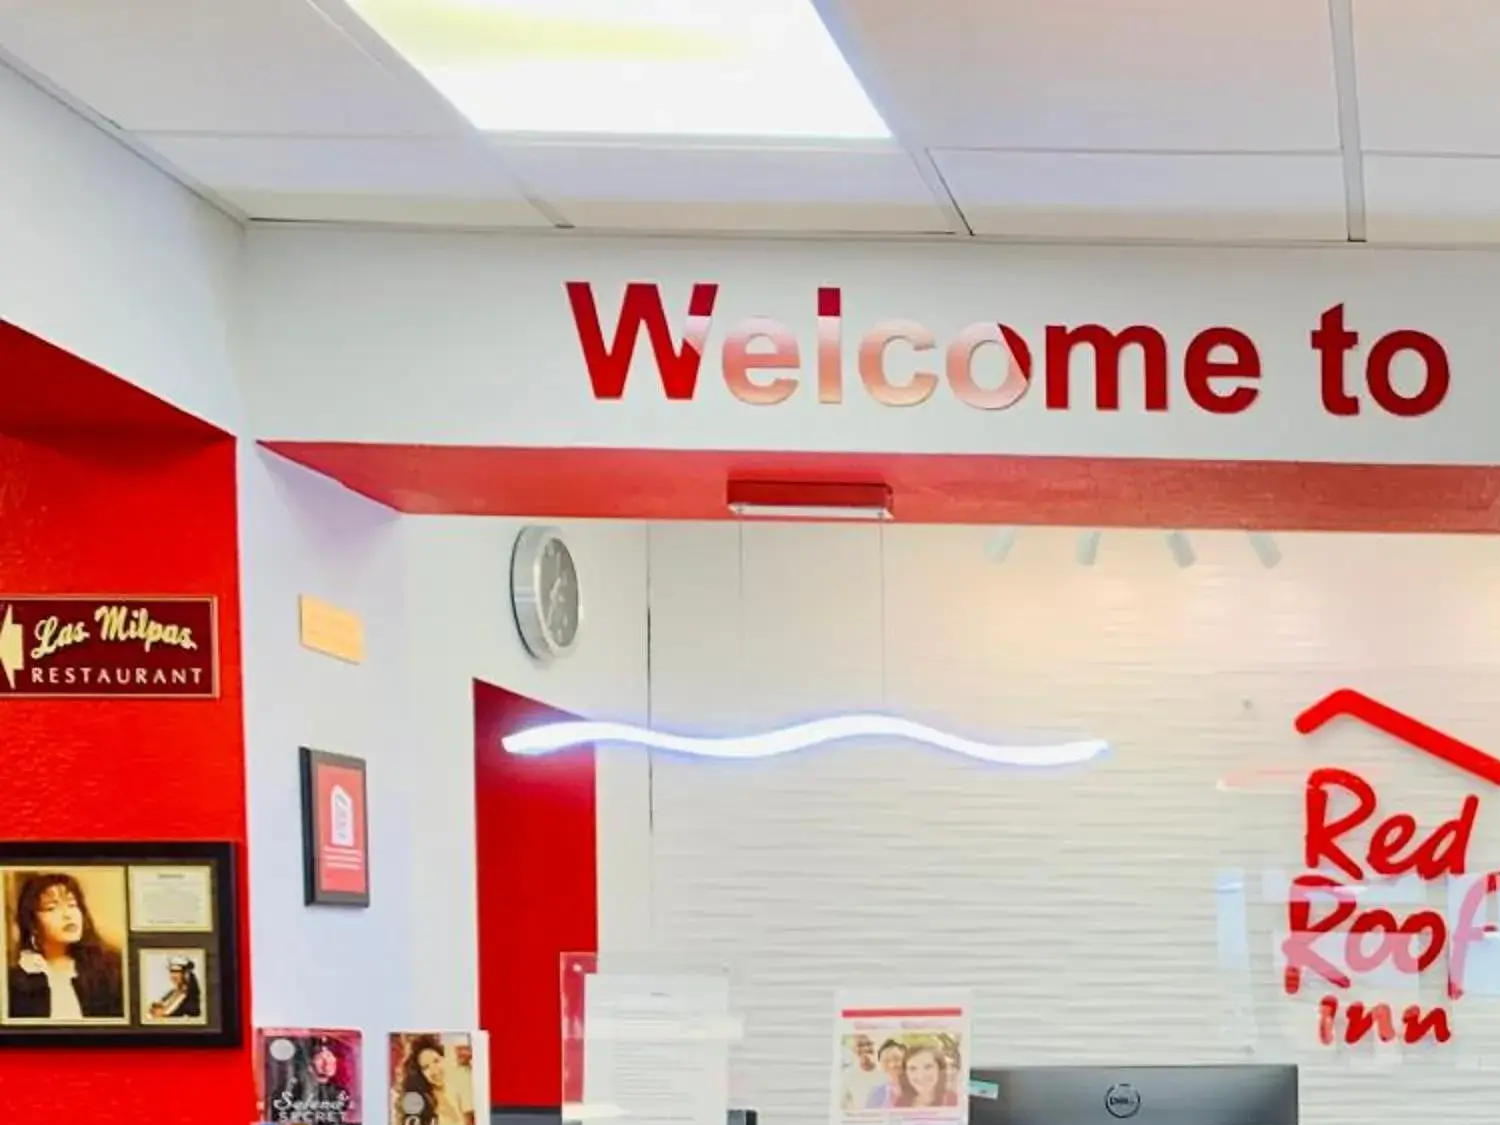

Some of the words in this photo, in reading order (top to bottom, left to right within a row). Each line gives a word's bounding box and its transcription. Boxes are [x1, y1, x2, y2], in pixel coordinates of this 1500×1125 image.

[565, 280, 1262, 416] Welcome
[1311, 304, 1451, 418] to
[31, 615, 90, 660] Las
[94, 604, 198, 653] Milpas
[31, 667, 203, 685] RESTAURANT
[1303, 767, 1480, 882] Red
